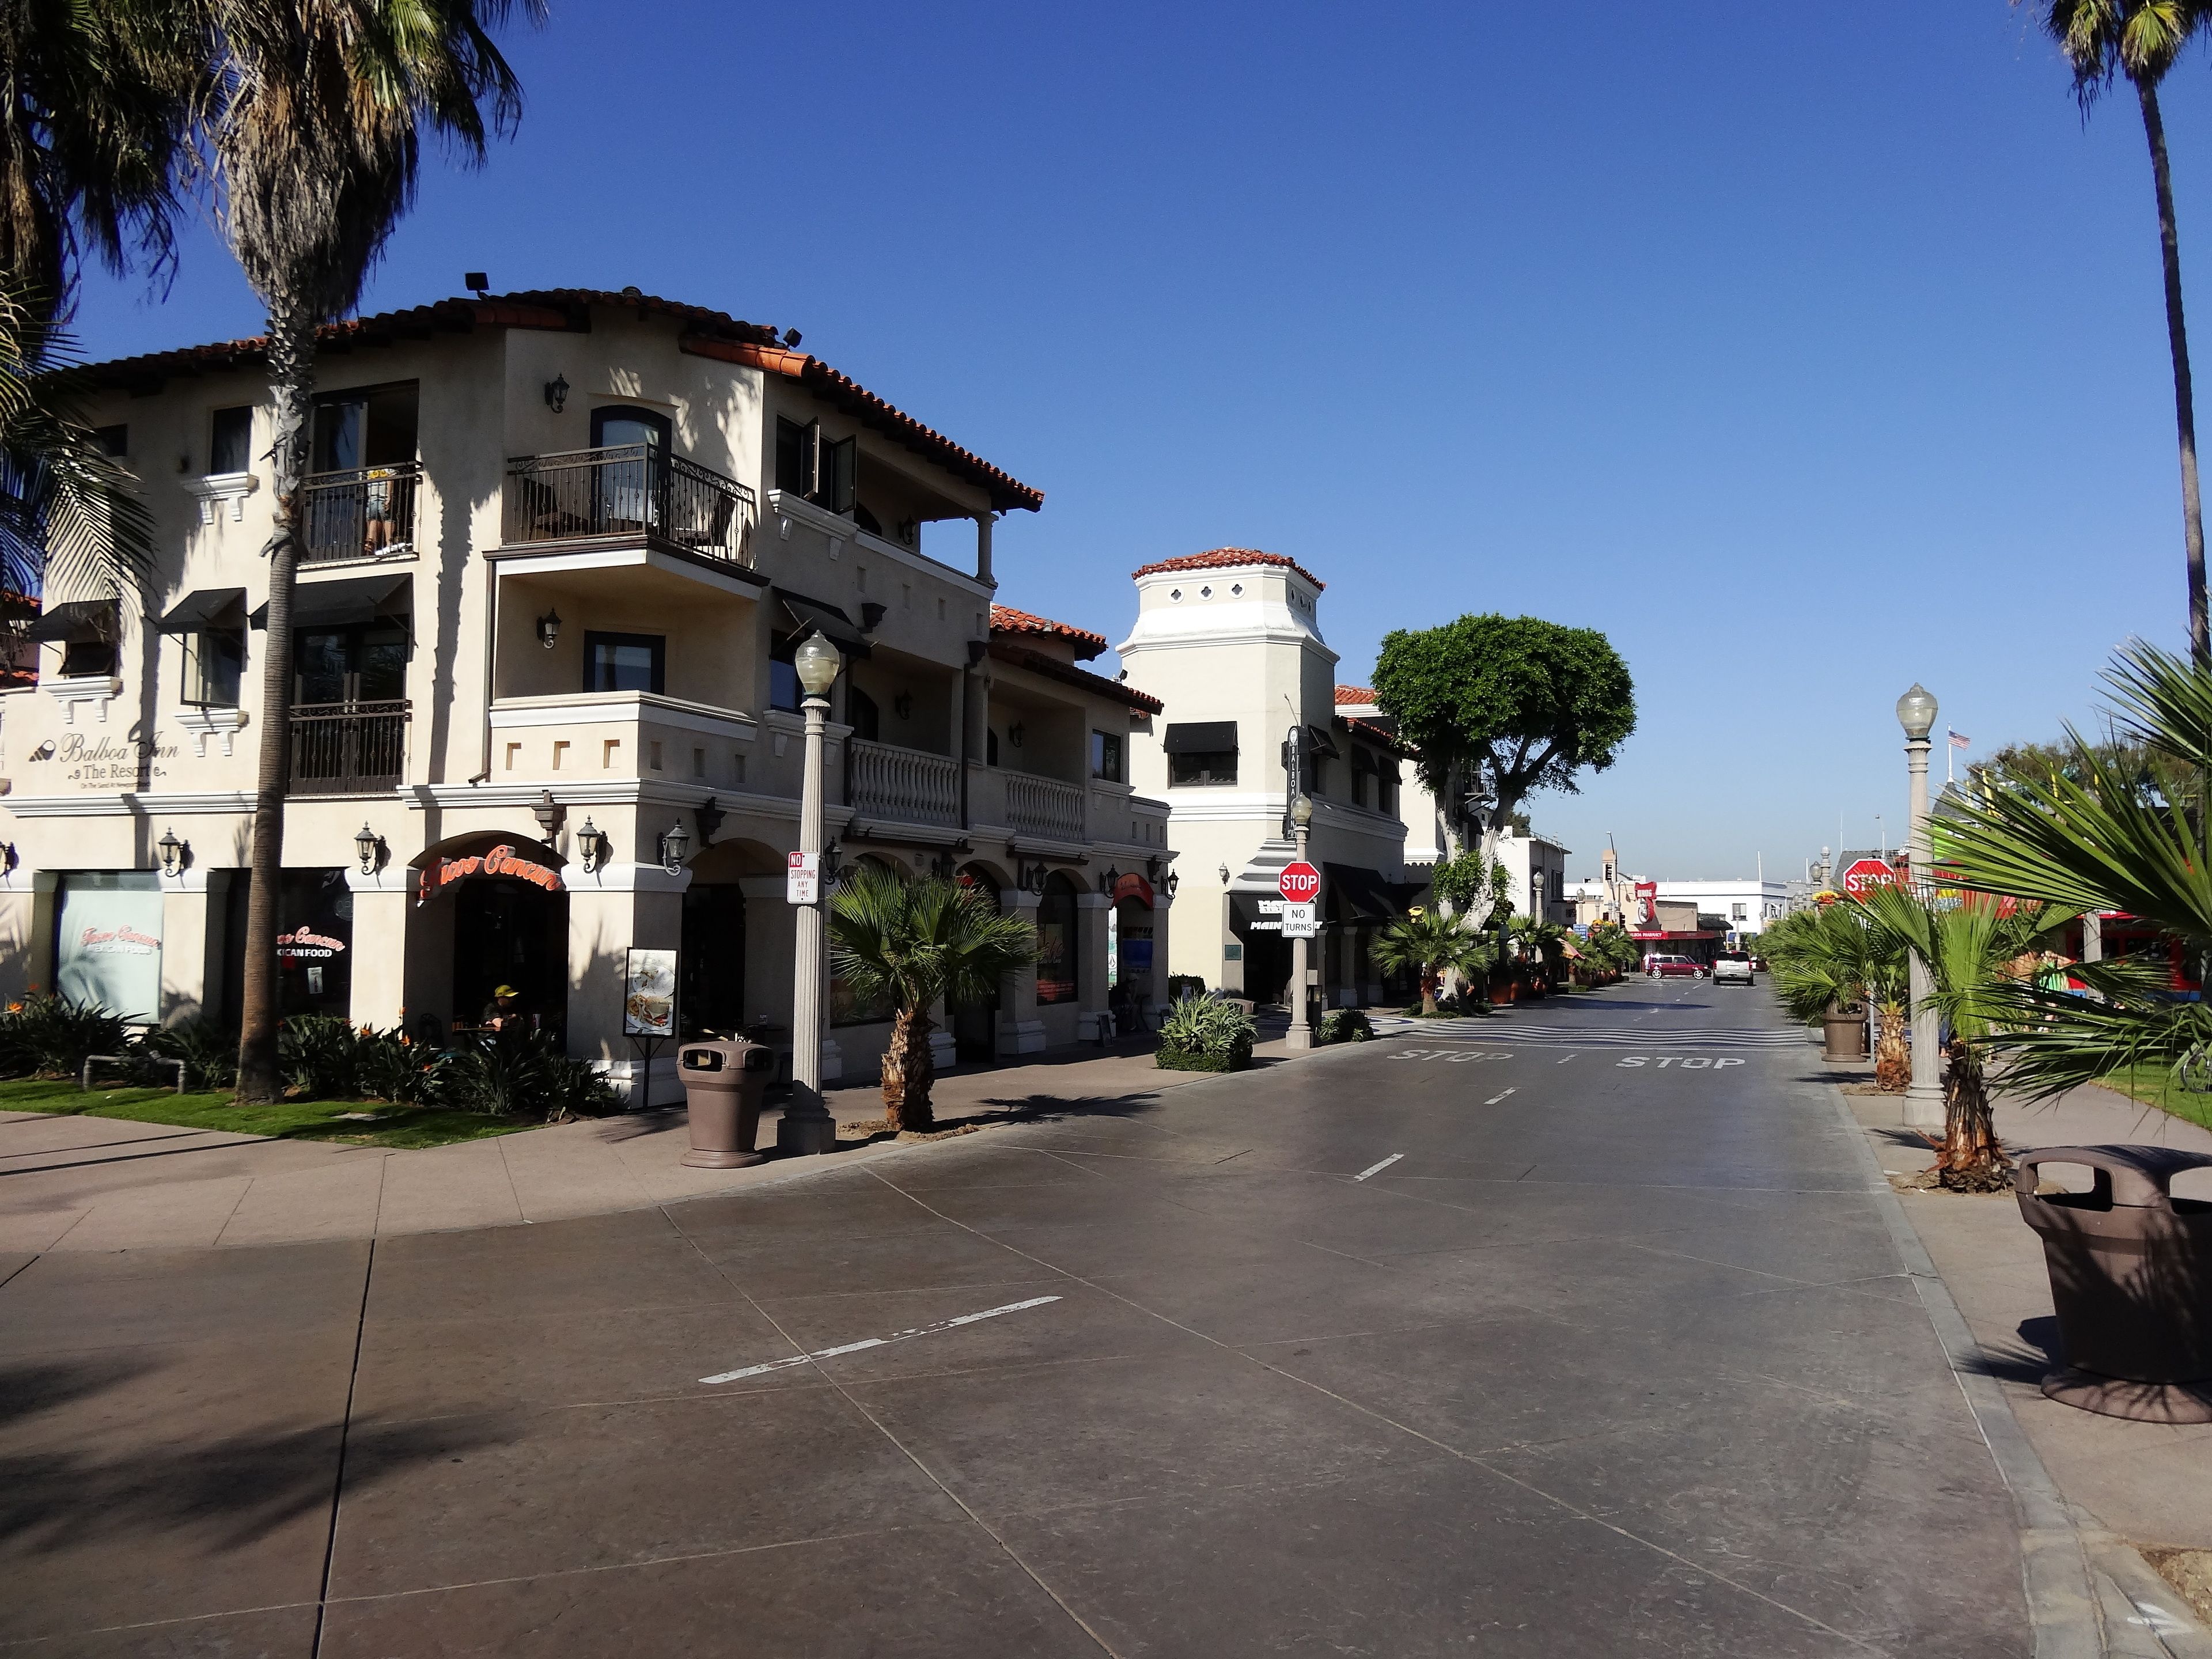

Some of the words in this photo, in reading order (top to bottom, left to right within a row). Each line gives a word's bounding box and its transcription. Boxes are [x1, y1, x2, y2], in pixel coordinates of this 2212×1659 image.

[59, 733, 128, 763] Balboa
[134, 730, 180, 759] Inn
[83, 764, 107, 779] The
[110, 763, 150, 778] Resort
[791, 854, 801, 866] NO
[419, 855, 480, 898] Tacos
[484, 844, 561, 891] Cancun
[790, 869, 816, 879] STOPPING
[1281, 874, 1317, 891] STOP
[1291, 910, 1305, 919] NO
[1285, 923, 1312, 931] TURNS
[294, 926, 346, 952] Cancun
[276, 949, 304, 957] XICAN
[304, 949, 333, 957] FOOD
[1387, 1050, 1514, 1063] STOP
[1615, 1056, 1746, 1069] STOP
